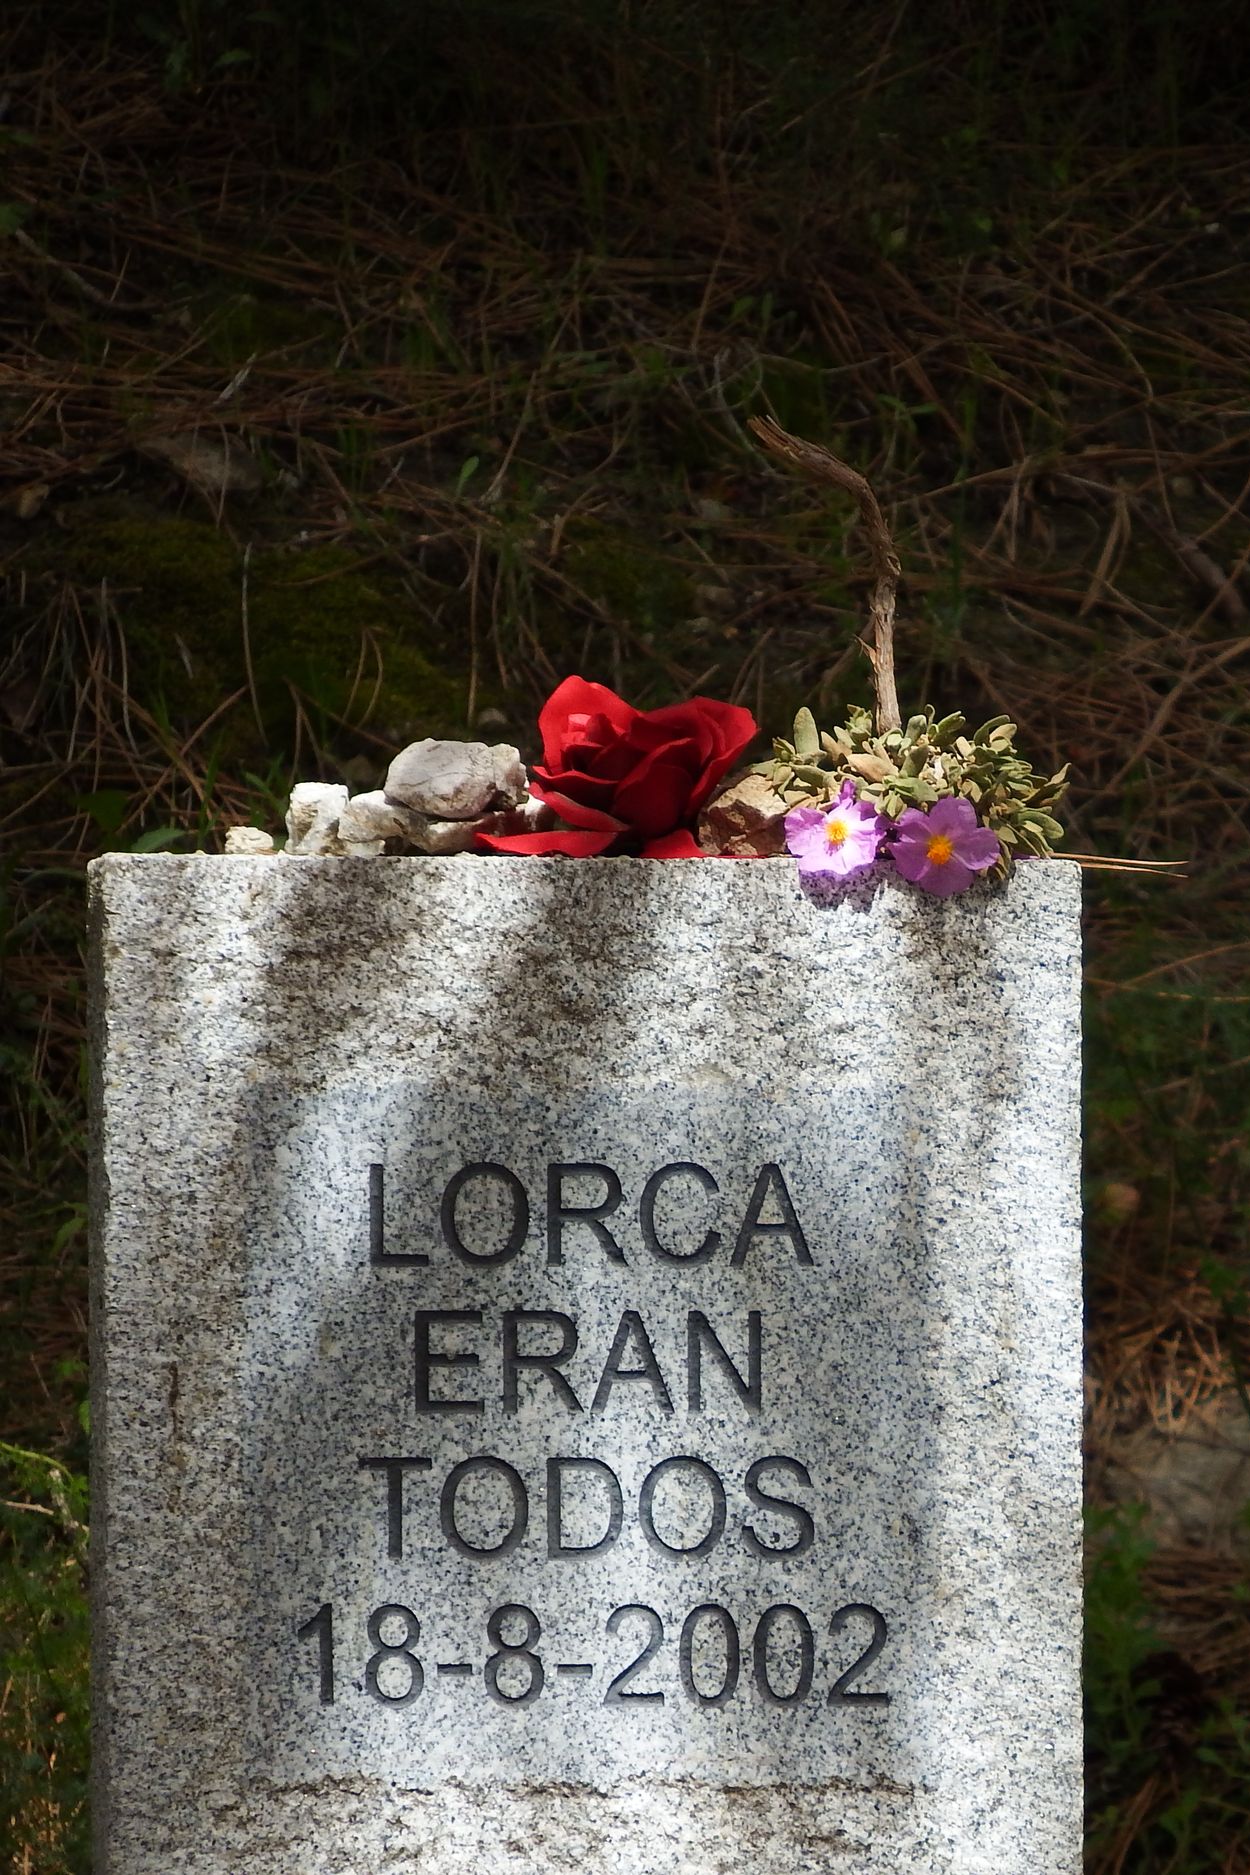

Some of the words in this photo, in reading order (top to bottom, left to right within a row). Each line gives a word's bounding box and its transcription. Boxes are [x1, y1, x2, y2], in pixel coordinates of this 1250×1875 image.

[366, 1161, 815, 1268] LORCA
[415, 1308, 765, 1412] ERAN
[362, 1452, 815, 1557] TODOS
[300, 1602, 892, 1704] 18-8-2002
